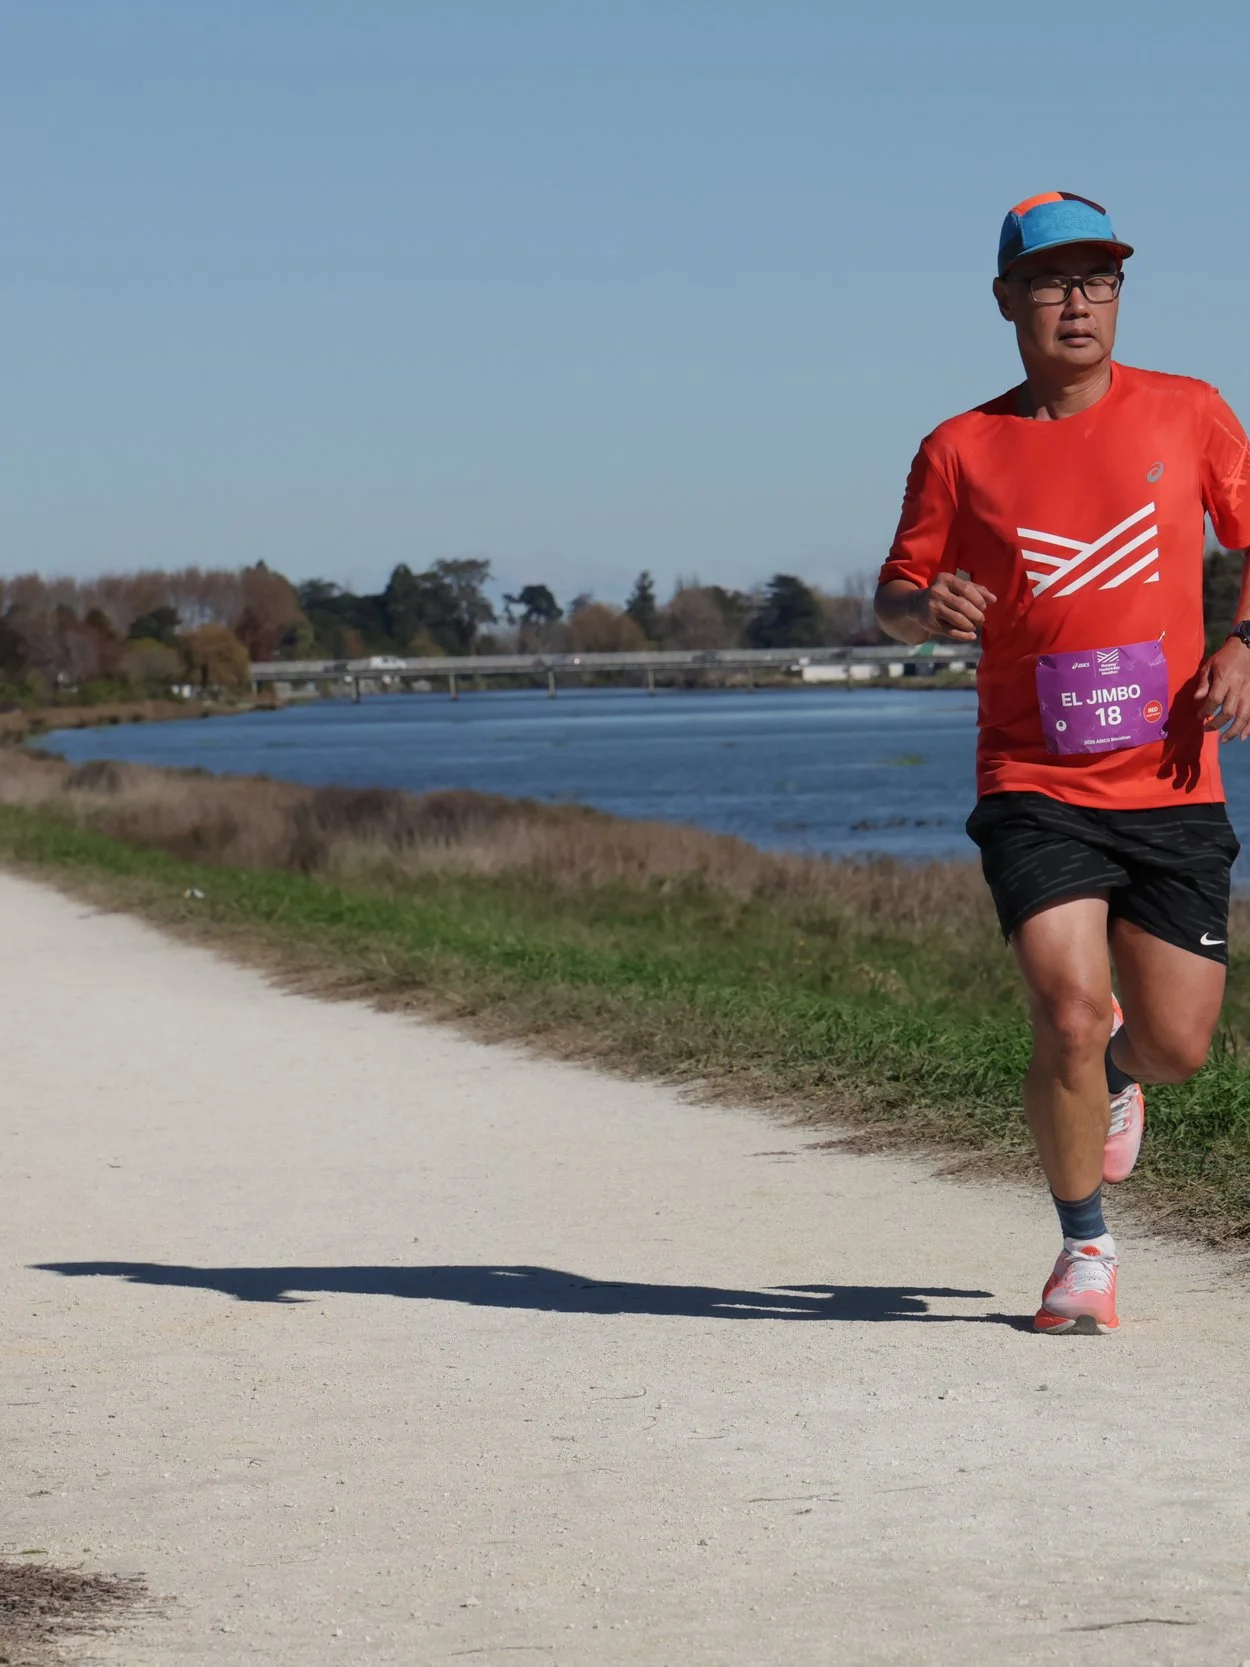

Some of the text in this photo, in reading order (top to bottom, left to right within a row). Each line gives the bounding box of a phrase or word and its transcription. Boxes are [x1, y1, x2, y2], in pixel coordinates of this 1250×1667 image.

[1061, 684, 1141, 707] EL JIMBO
[1095, 705, 1122, 727] 18
